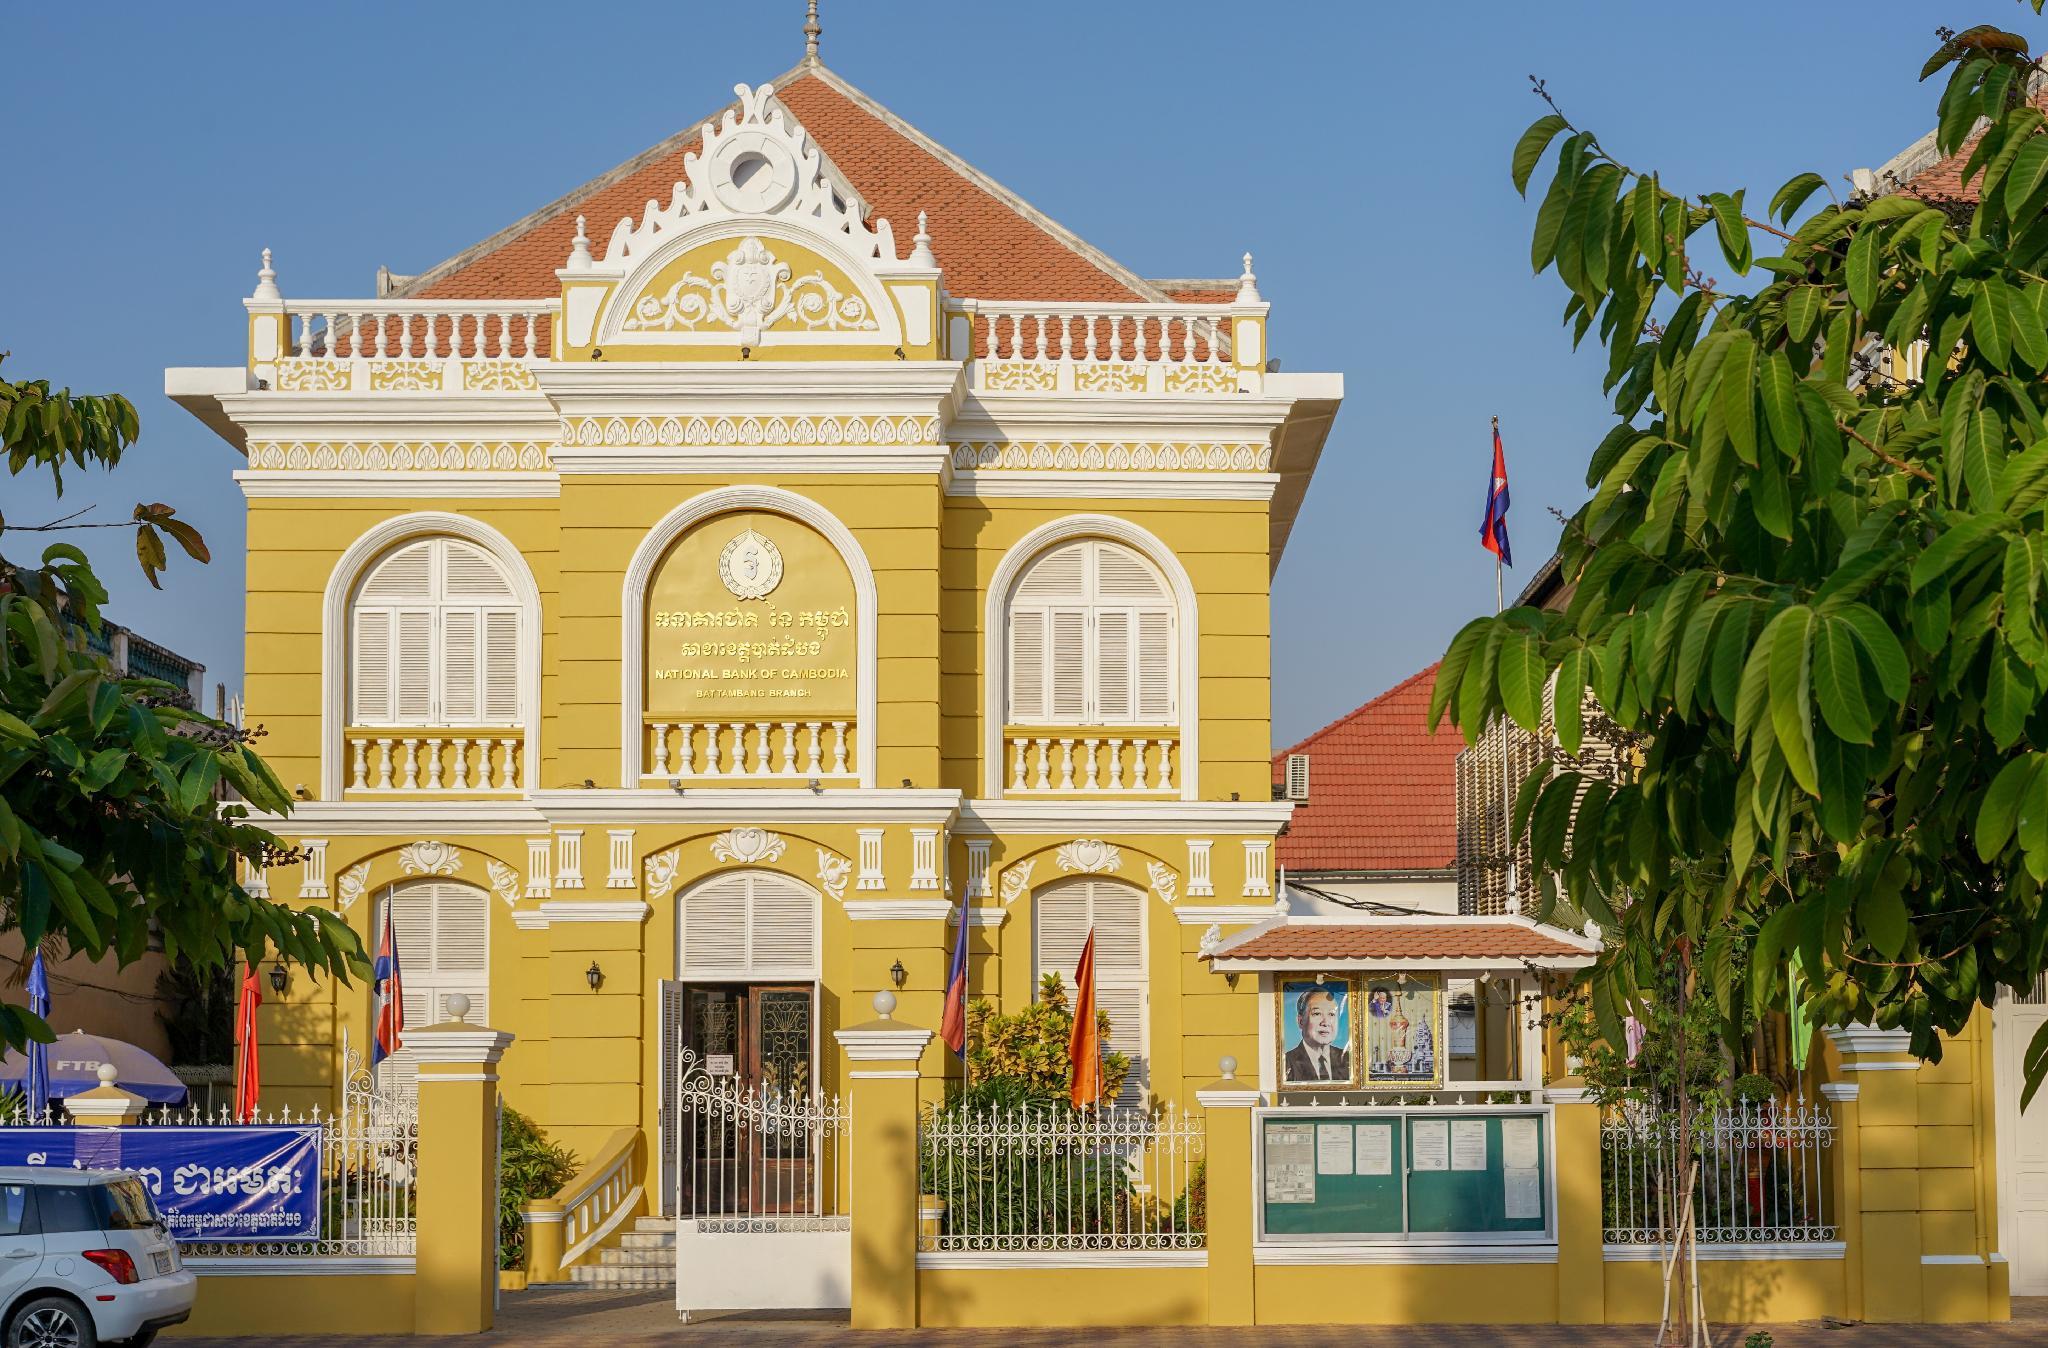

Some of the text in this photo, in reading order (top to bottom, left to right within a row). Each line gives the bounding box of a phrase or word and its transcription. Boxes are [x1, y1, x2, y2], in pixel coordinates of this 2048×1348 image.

[799, 606, 849, 641] កម្ពុជា
[655, 668, 849, 680] NATIONAL BANK OF CAMBODIA
[696, 689, 812, 698] BATTAMBANG BRANCH
